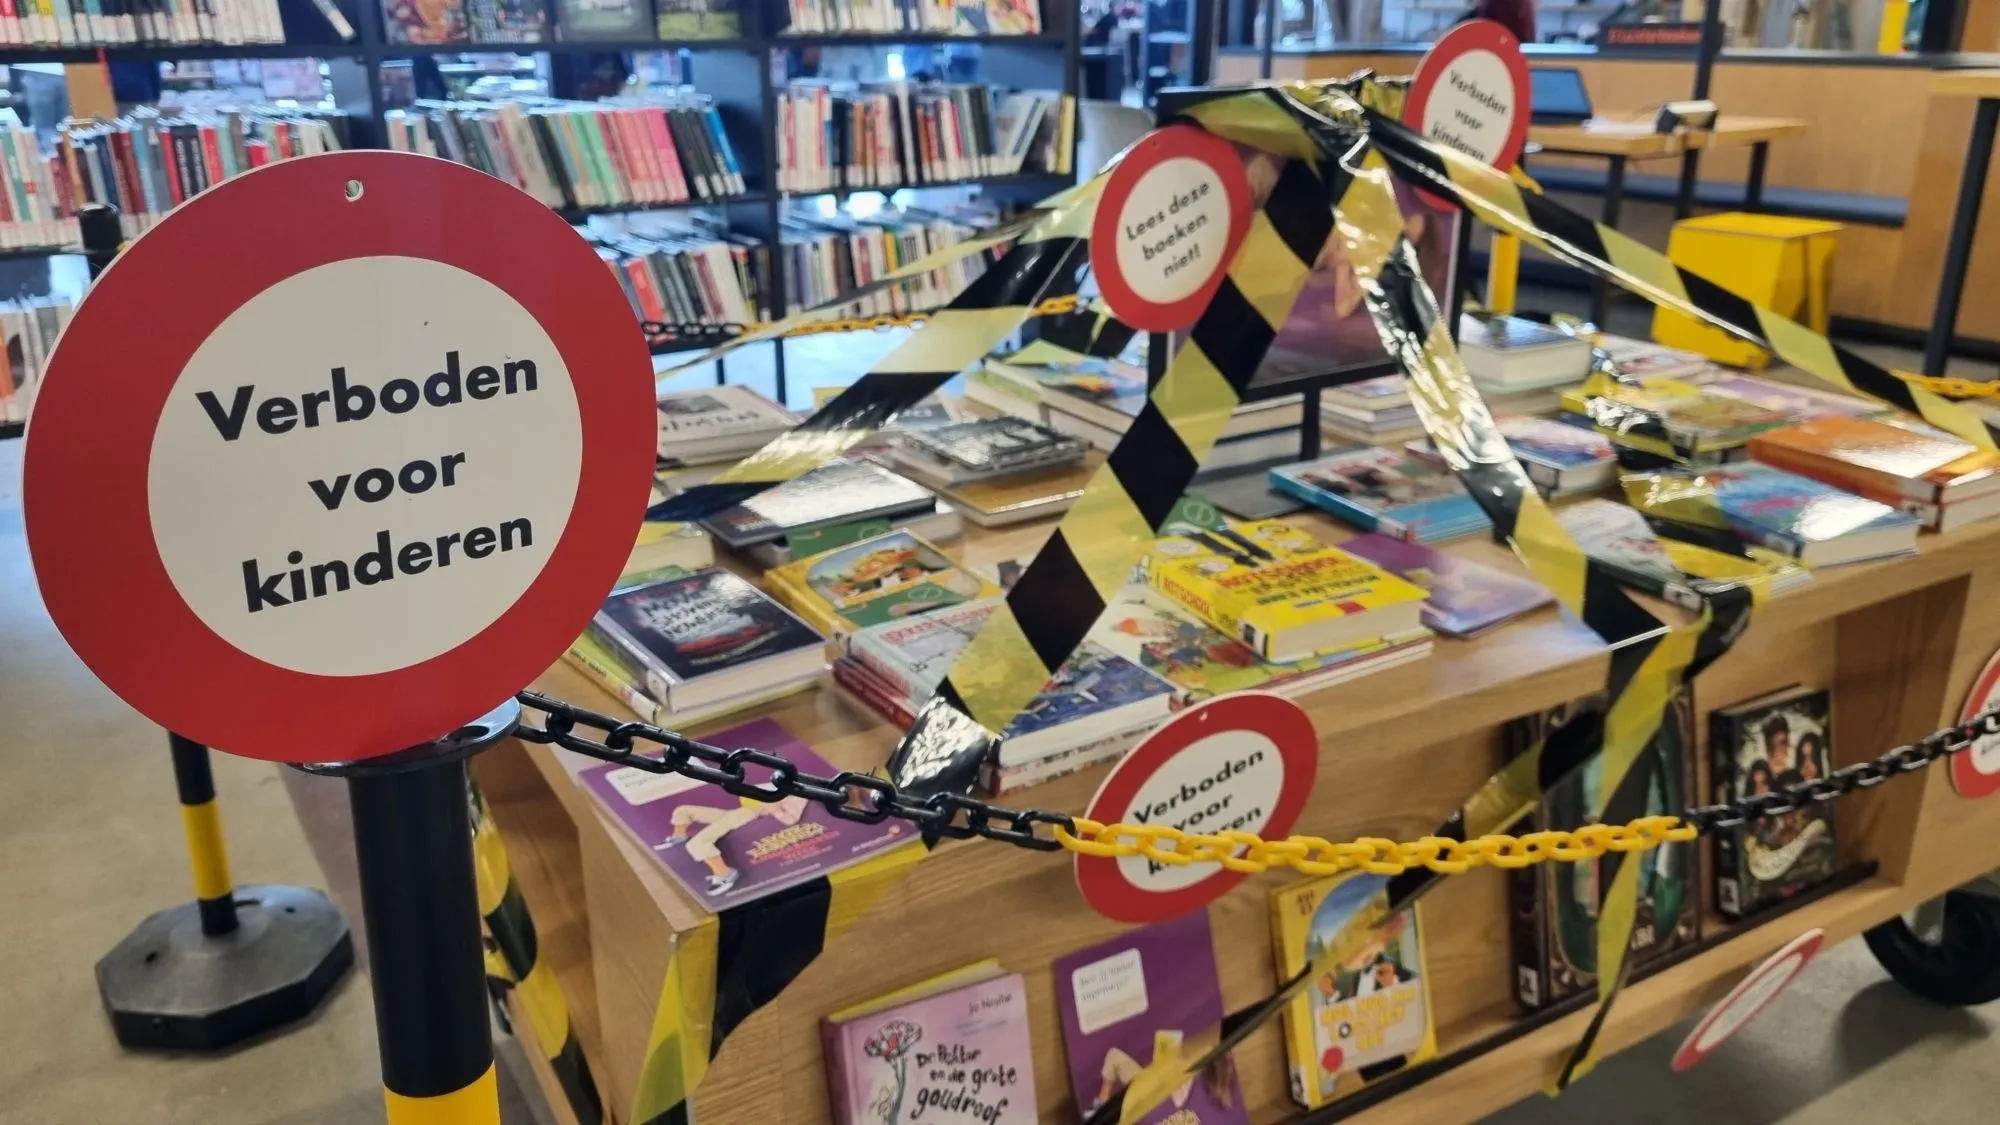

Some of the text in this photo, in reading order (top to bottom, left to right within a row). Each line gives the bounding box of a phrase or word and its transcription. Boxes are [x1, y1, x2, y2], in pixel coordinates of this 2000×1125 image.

[1126, 183, 1209, 242] Lees deze
[1142, 213, 1208, 261] boeken
[1163, 243, 1200, 278] niet!
[195, 350, 538, 442] Verboden
[307, 452, 466, 511] voor
[242, 517, 534, 613] kinderen
[1133, 750, 1264, 825] Verboden
[1173, 793, 1234, 831] voor
[910, 1086, 1009, 1125] goudroof
[929, 1069, 946, 1081] en
[971, 1064, 1018, 1095] grote
